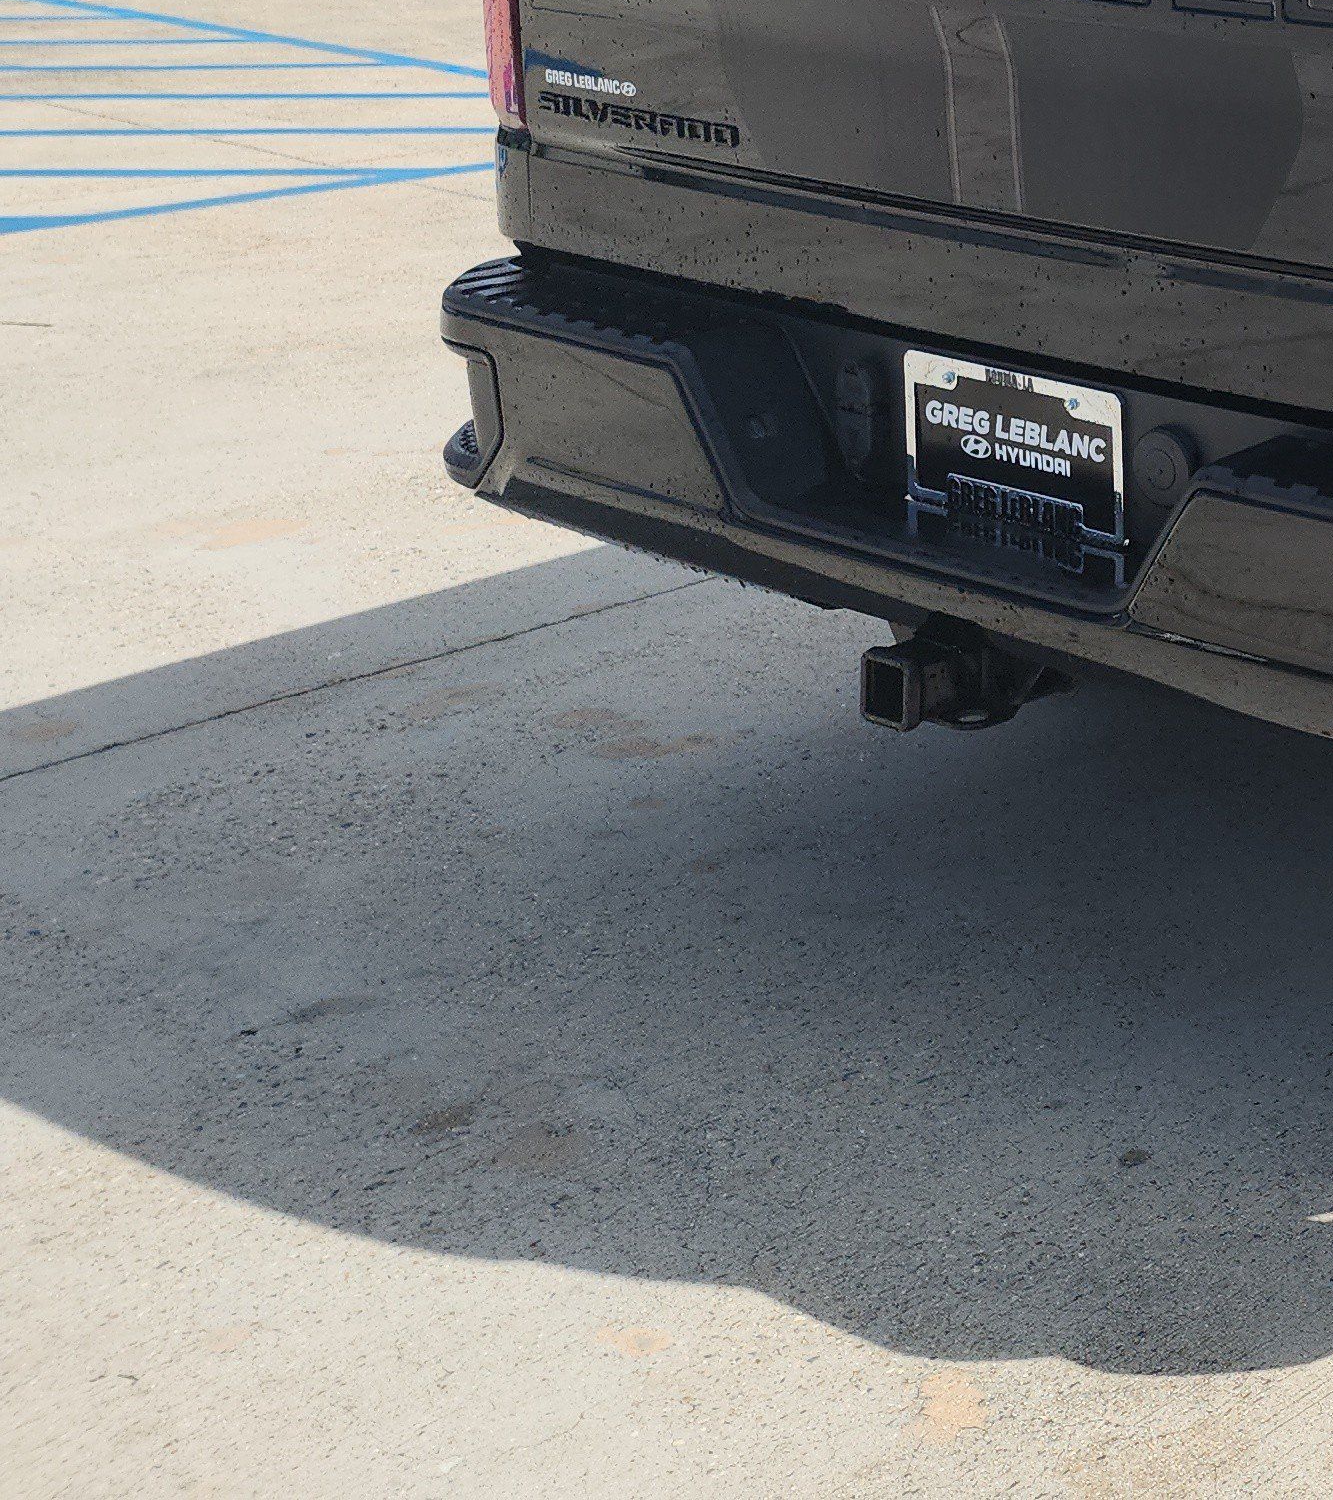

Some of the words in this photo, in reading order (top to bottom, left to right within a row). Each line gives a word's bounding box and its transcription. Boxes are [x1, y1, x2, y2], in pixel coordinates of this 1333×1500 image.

[545, 69, 572, 88] GREG
[537, 90, 741, 149] SILVERADO
[925, 400, 991, 435] GREG
[995, 415, 1107, 462] LEBLANC
[994, 443, 1071, 477] HYUNDAI
